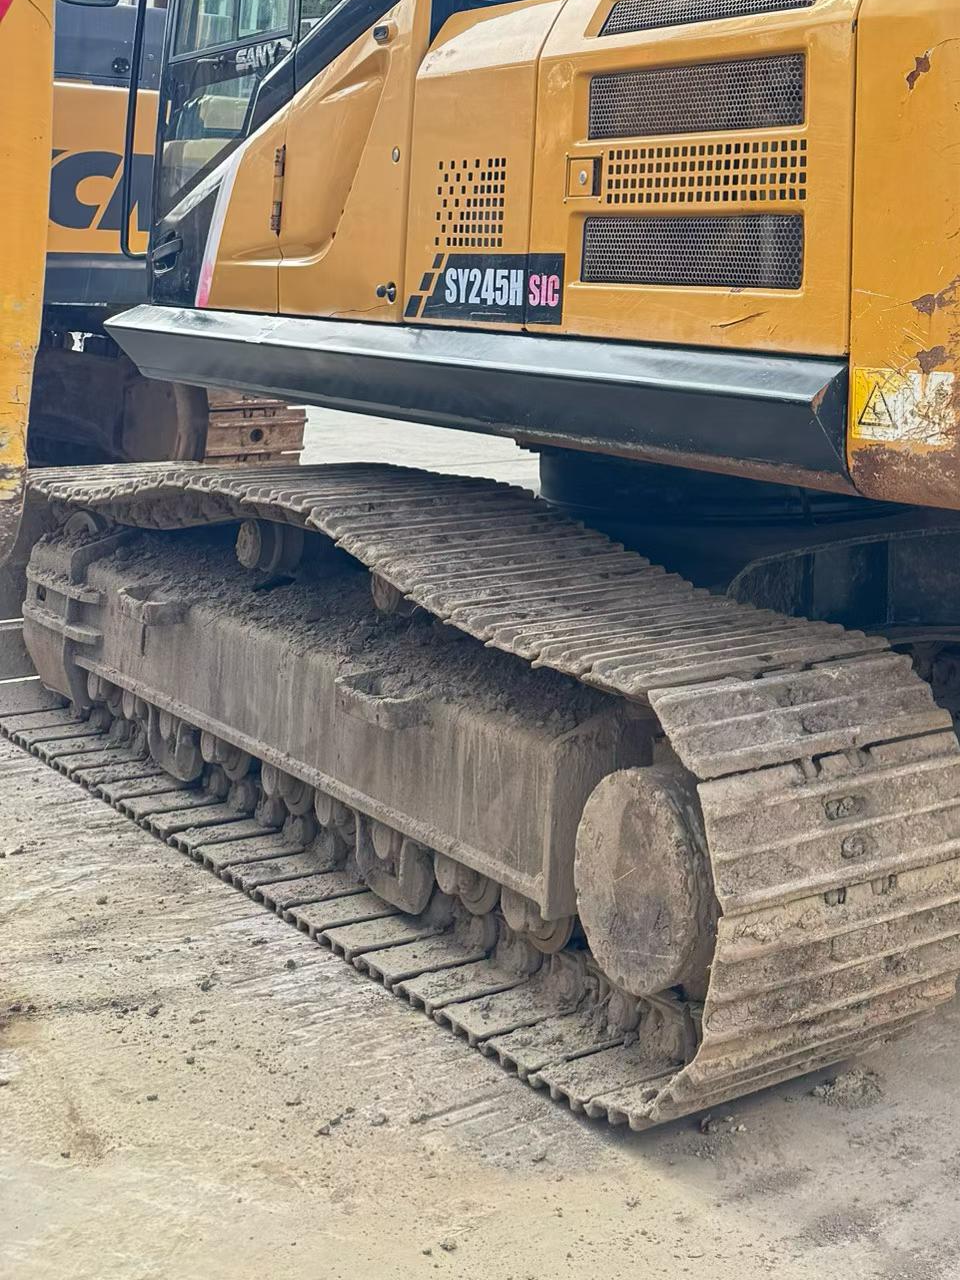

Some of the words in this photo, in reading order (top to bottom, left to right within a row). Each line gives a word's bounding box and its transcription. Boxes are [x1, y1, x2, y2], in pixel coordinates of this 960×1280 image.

[235, 41, 277, 71] SANY
[445, 267, 524, 306] SY245H
[528, 273, 560, 307] SIC
